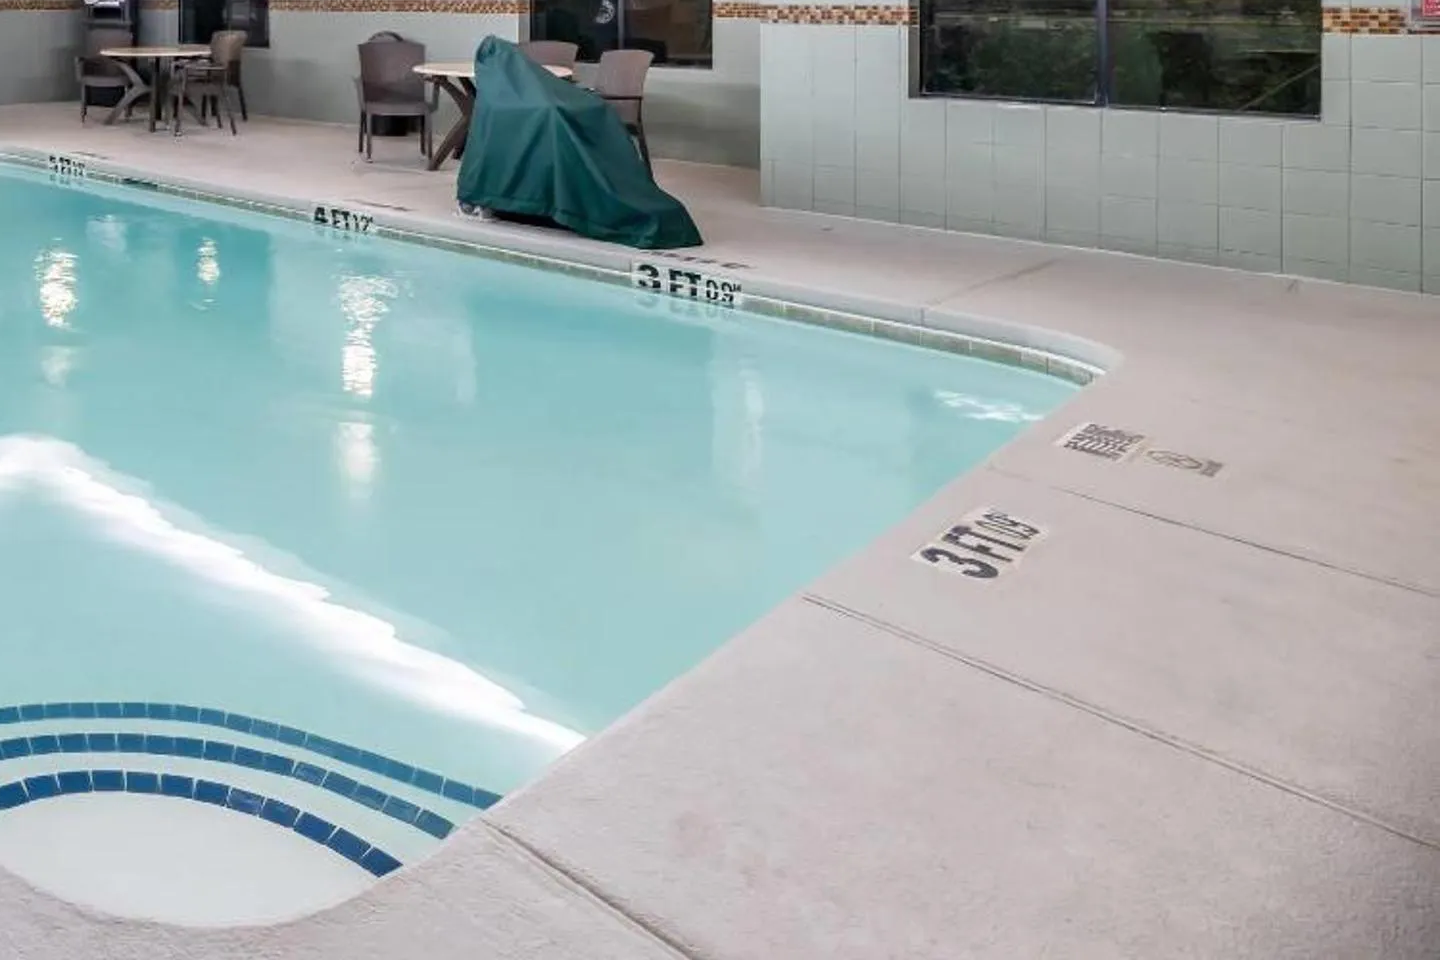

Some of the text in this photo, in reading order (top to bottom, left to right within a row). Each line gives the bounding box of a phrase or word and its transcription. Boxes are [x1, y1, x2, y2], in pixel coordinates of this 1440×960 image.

[314, 207, 328, 224] 4
[331, 208, 350, 230] FT
[637, 263, 662, 291] 3
[668, 268, 702, 298] FT
[940, 525, 1027, 563] FT
[920, 547, 999, 579] 3
